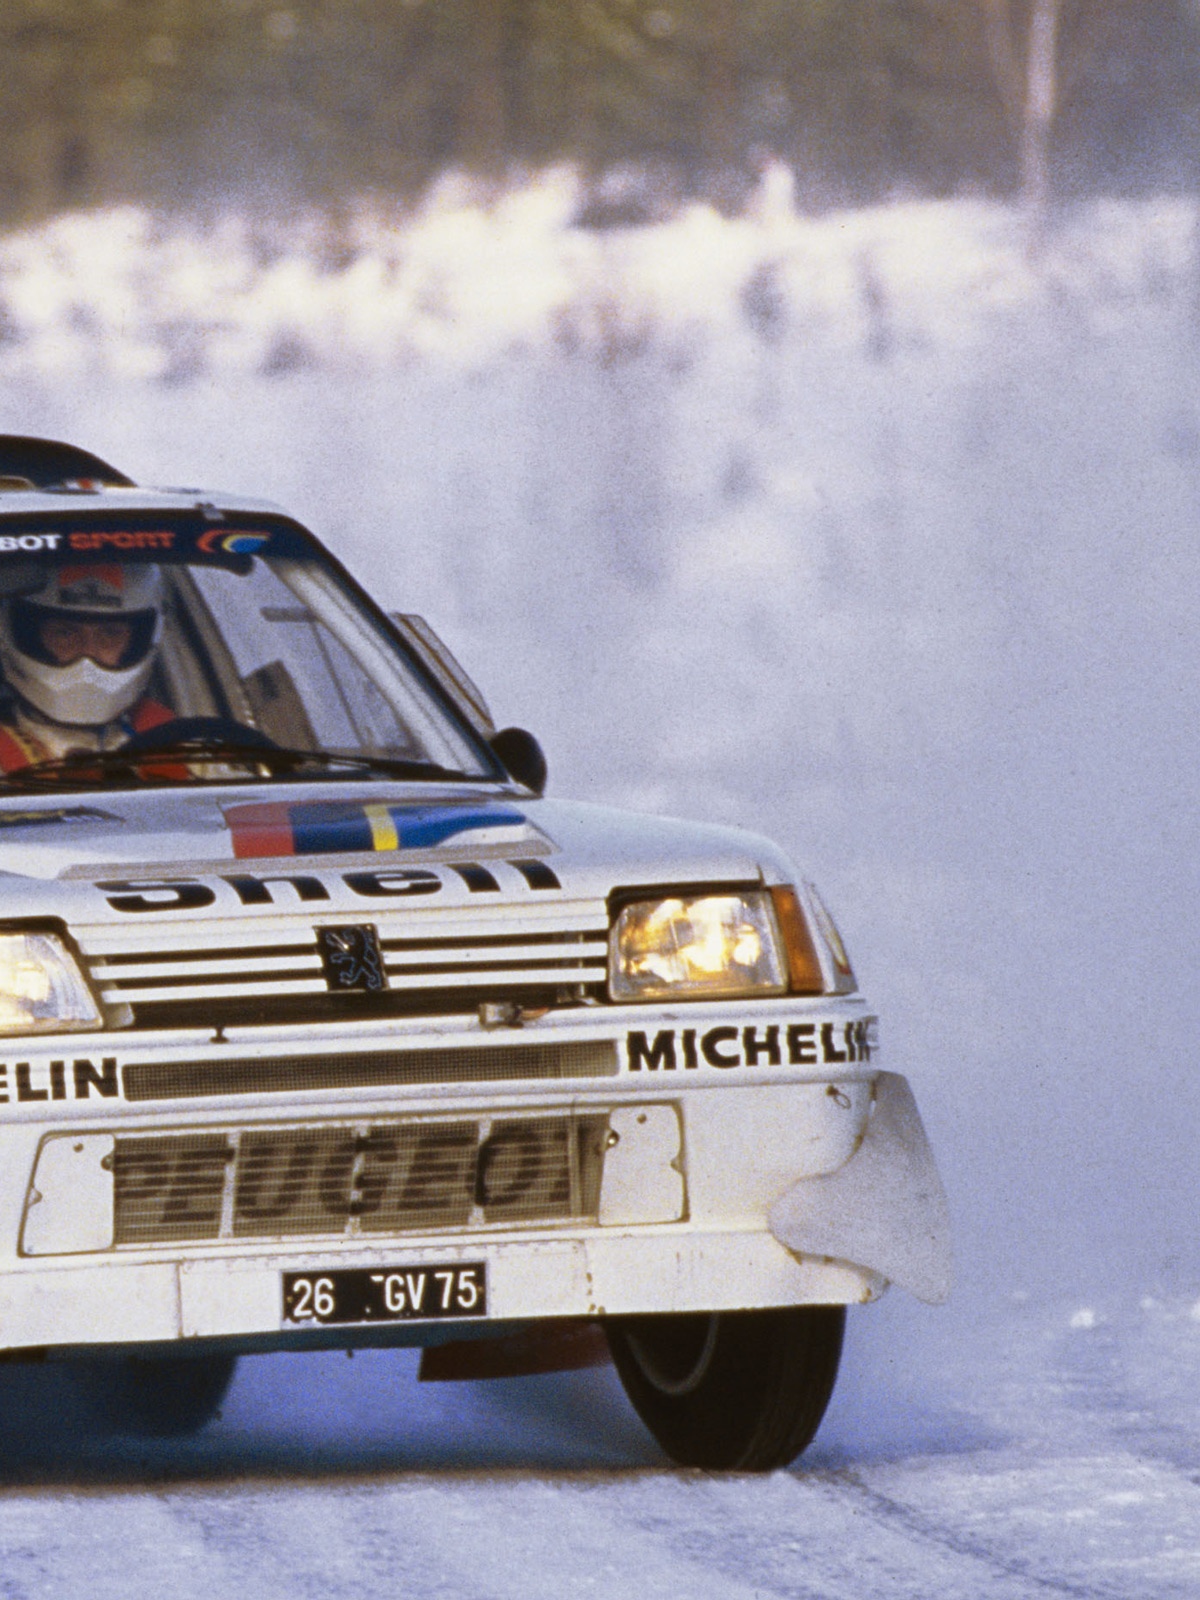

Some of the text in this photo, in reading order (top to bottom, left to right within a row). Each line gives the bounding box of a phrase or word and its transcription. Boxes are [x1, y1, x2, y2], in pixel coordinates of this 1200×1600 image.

[69, 531, 176, 550] SPORT
[93, 858, 562, 913] Shell
[293, 1278, 334, 1317] 26
[435, 1271, 477, 1309] 75
